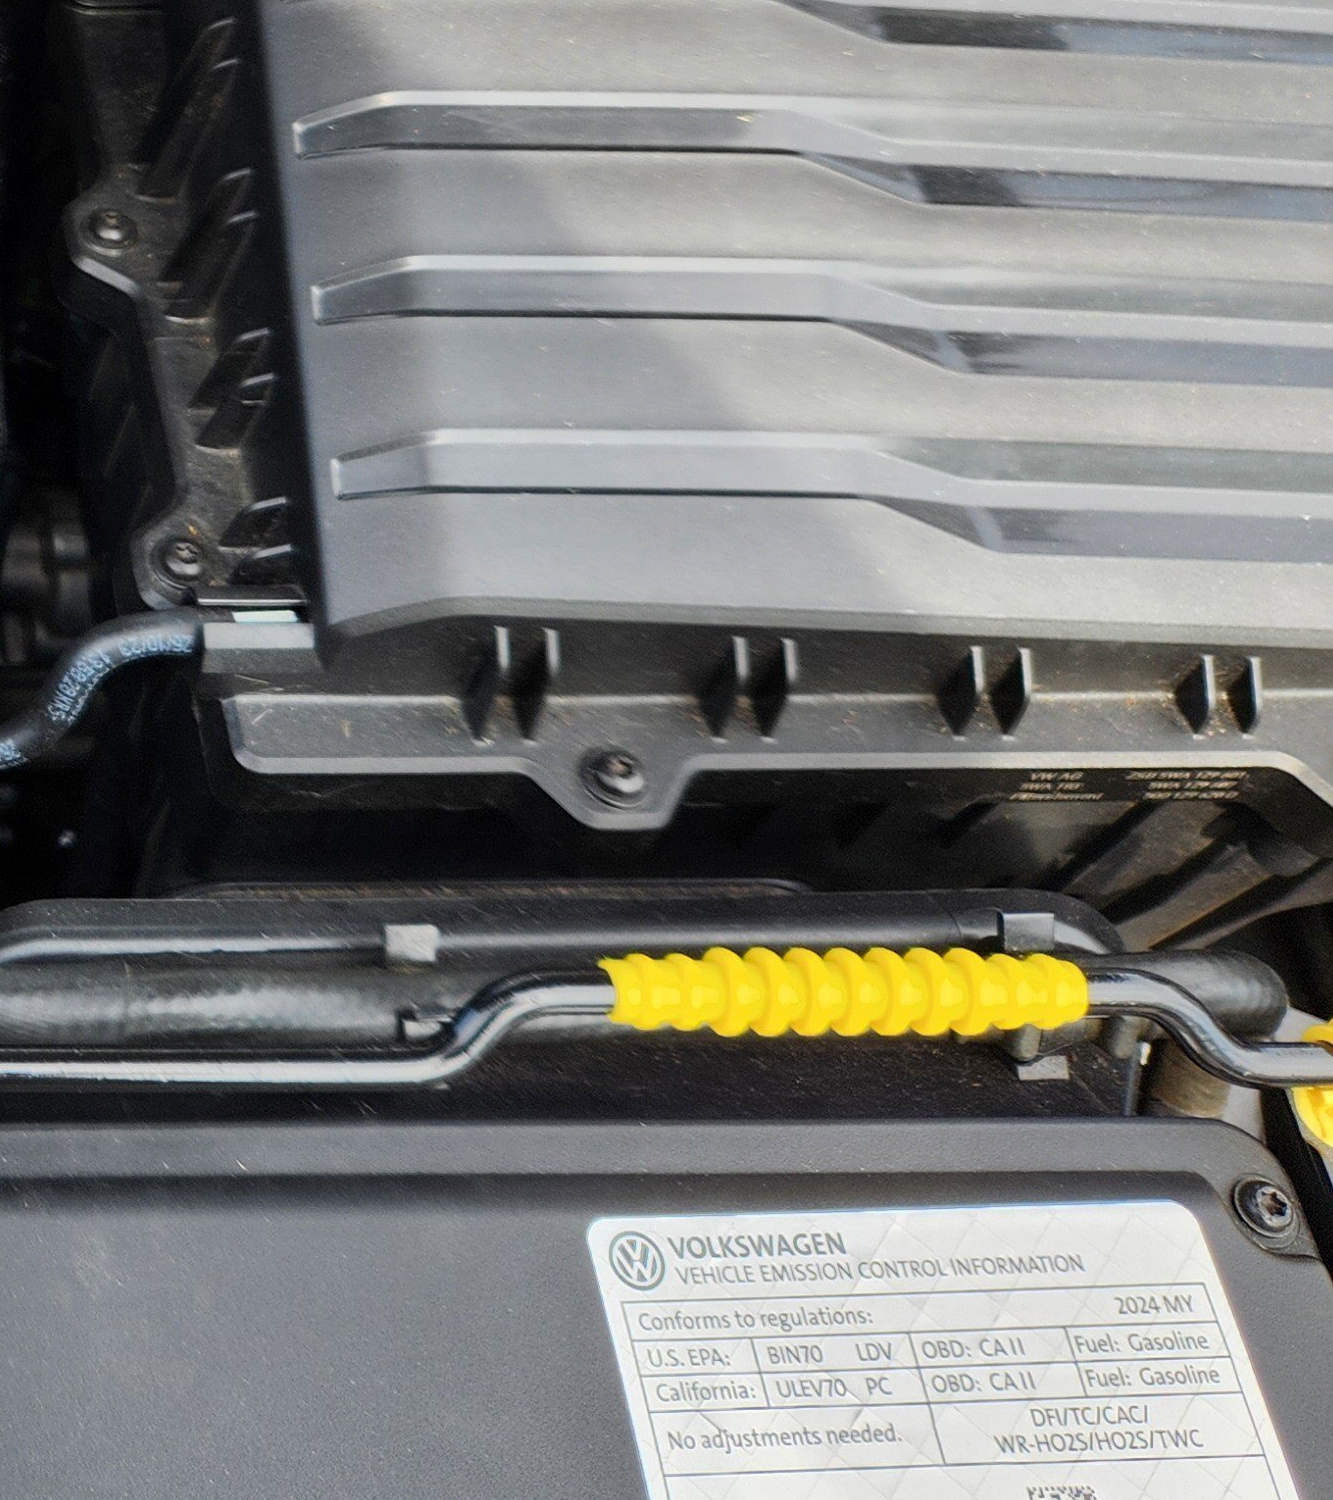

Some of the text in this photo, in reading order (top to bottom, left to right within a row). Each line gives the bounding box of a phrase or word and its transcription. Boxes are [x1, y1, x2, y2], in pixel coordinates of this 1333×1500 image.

[666, 1232, 847, 1259] VOLKSWAGEN
[674, 1254, 1085, 1285] VEHICLE EMISSION CONTROL INFORMATION
[1113, 1294, 1193, 1315] 2024 MY
[638, 1305, 873, 1333] Conforms to regulations:
[854, 1341, 892, 1361] LDV
[921, 1336, 1026, 1359] OBD: CA II
[1073, 1330, 1210, 1354] Fuel: Gasoline
[646, 1347, 731, 1368] U.S. EPA:
[766, 1344, 823, 1364] BIN70
[775, 1375, 849, 1398] ULEV70
[864, 1376, 893, 1396] PC
[931, 1371, 1037, 1393] OBD: CA II
[1084, 1363, 1221, 1387] Fuel: Gasoline
[655, 1379, 756, 1405] California:
[666, 1422, 902, 1455] No adjustments needed.
